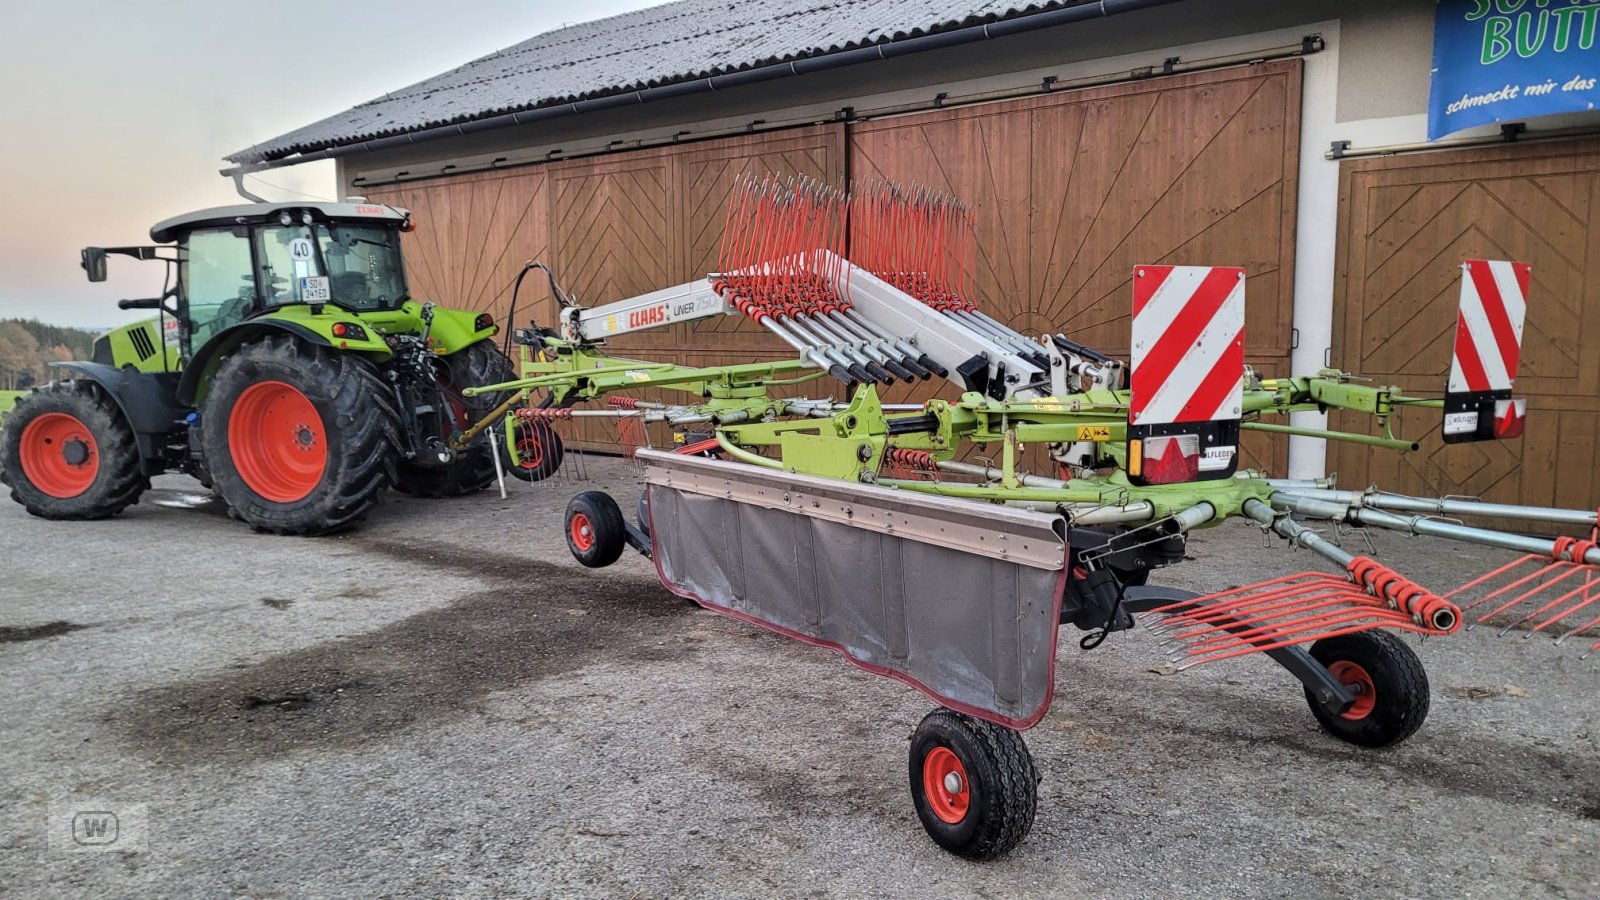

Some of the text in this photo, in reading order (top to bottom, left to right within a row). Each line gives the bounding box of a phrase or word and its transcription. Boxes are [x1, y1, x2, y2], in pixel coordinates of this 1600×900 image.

[1445, 75, 1597, 115] schmeckt mir das
[293, 242, 309, 258] 40
[629, 295, 717, 328] CLAAS LINER 750
